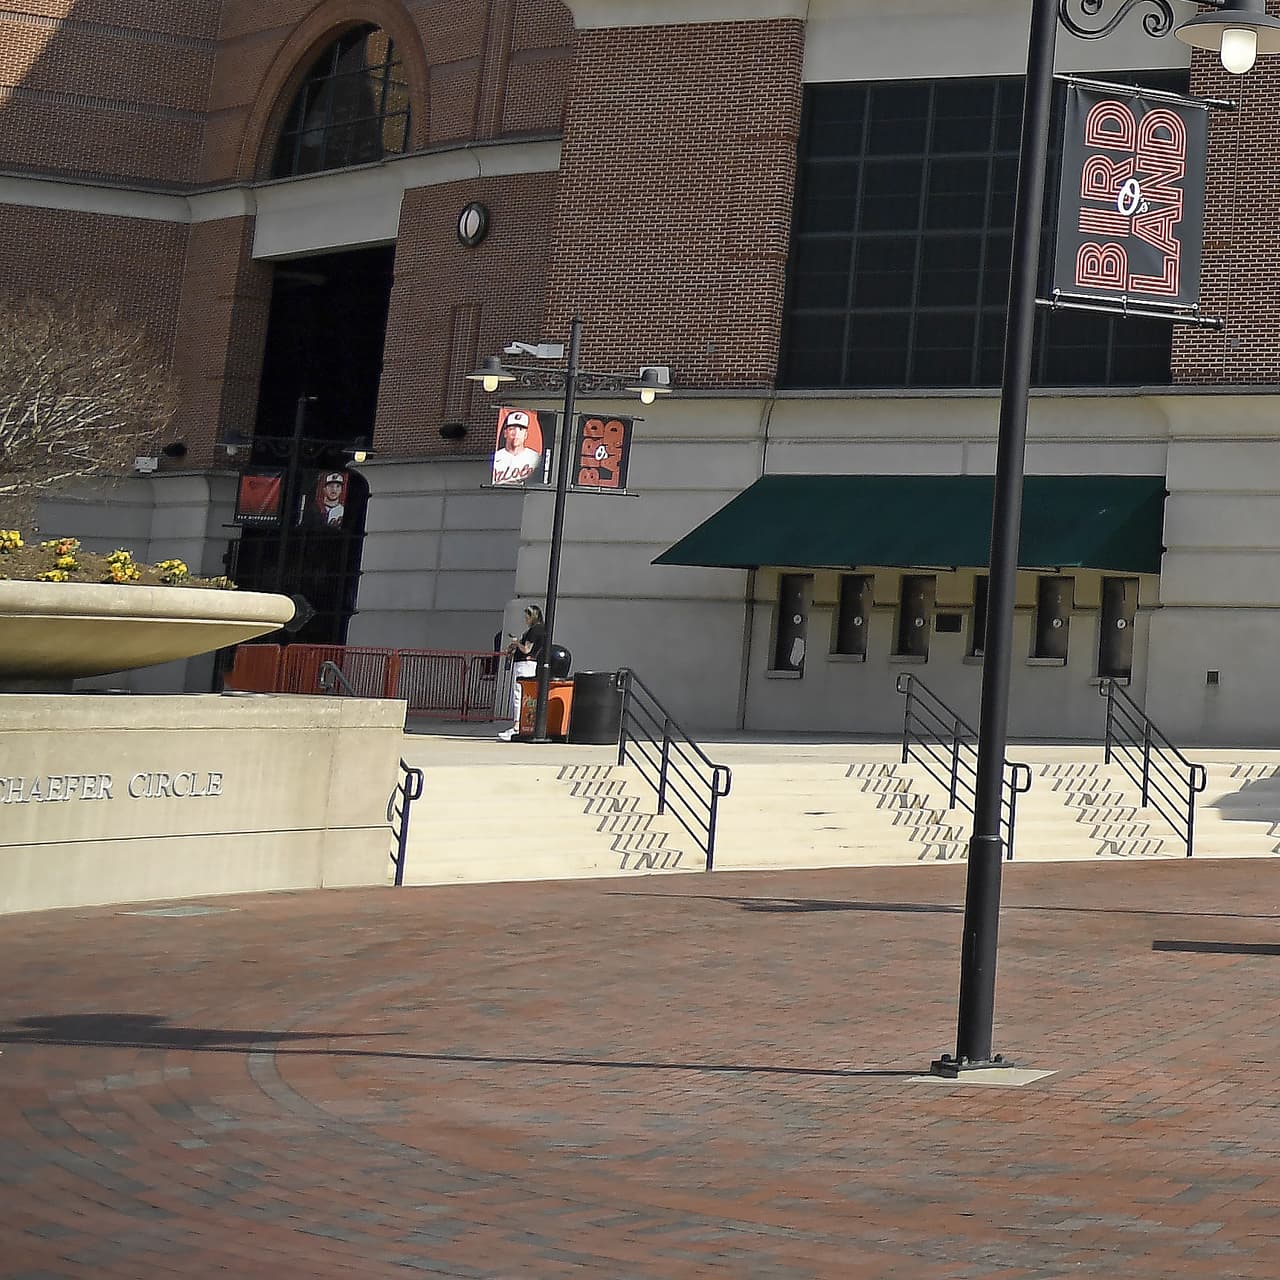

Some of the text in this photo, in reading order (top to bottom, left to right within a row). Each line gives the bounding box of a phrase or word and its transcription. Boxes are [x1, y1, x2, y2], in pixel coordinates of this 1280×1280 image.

[1075, 99, 1138, 291] BIRD
[1128, 107, 1188, 297] LAND
[127, 771, 224, 799] CIRCLE
